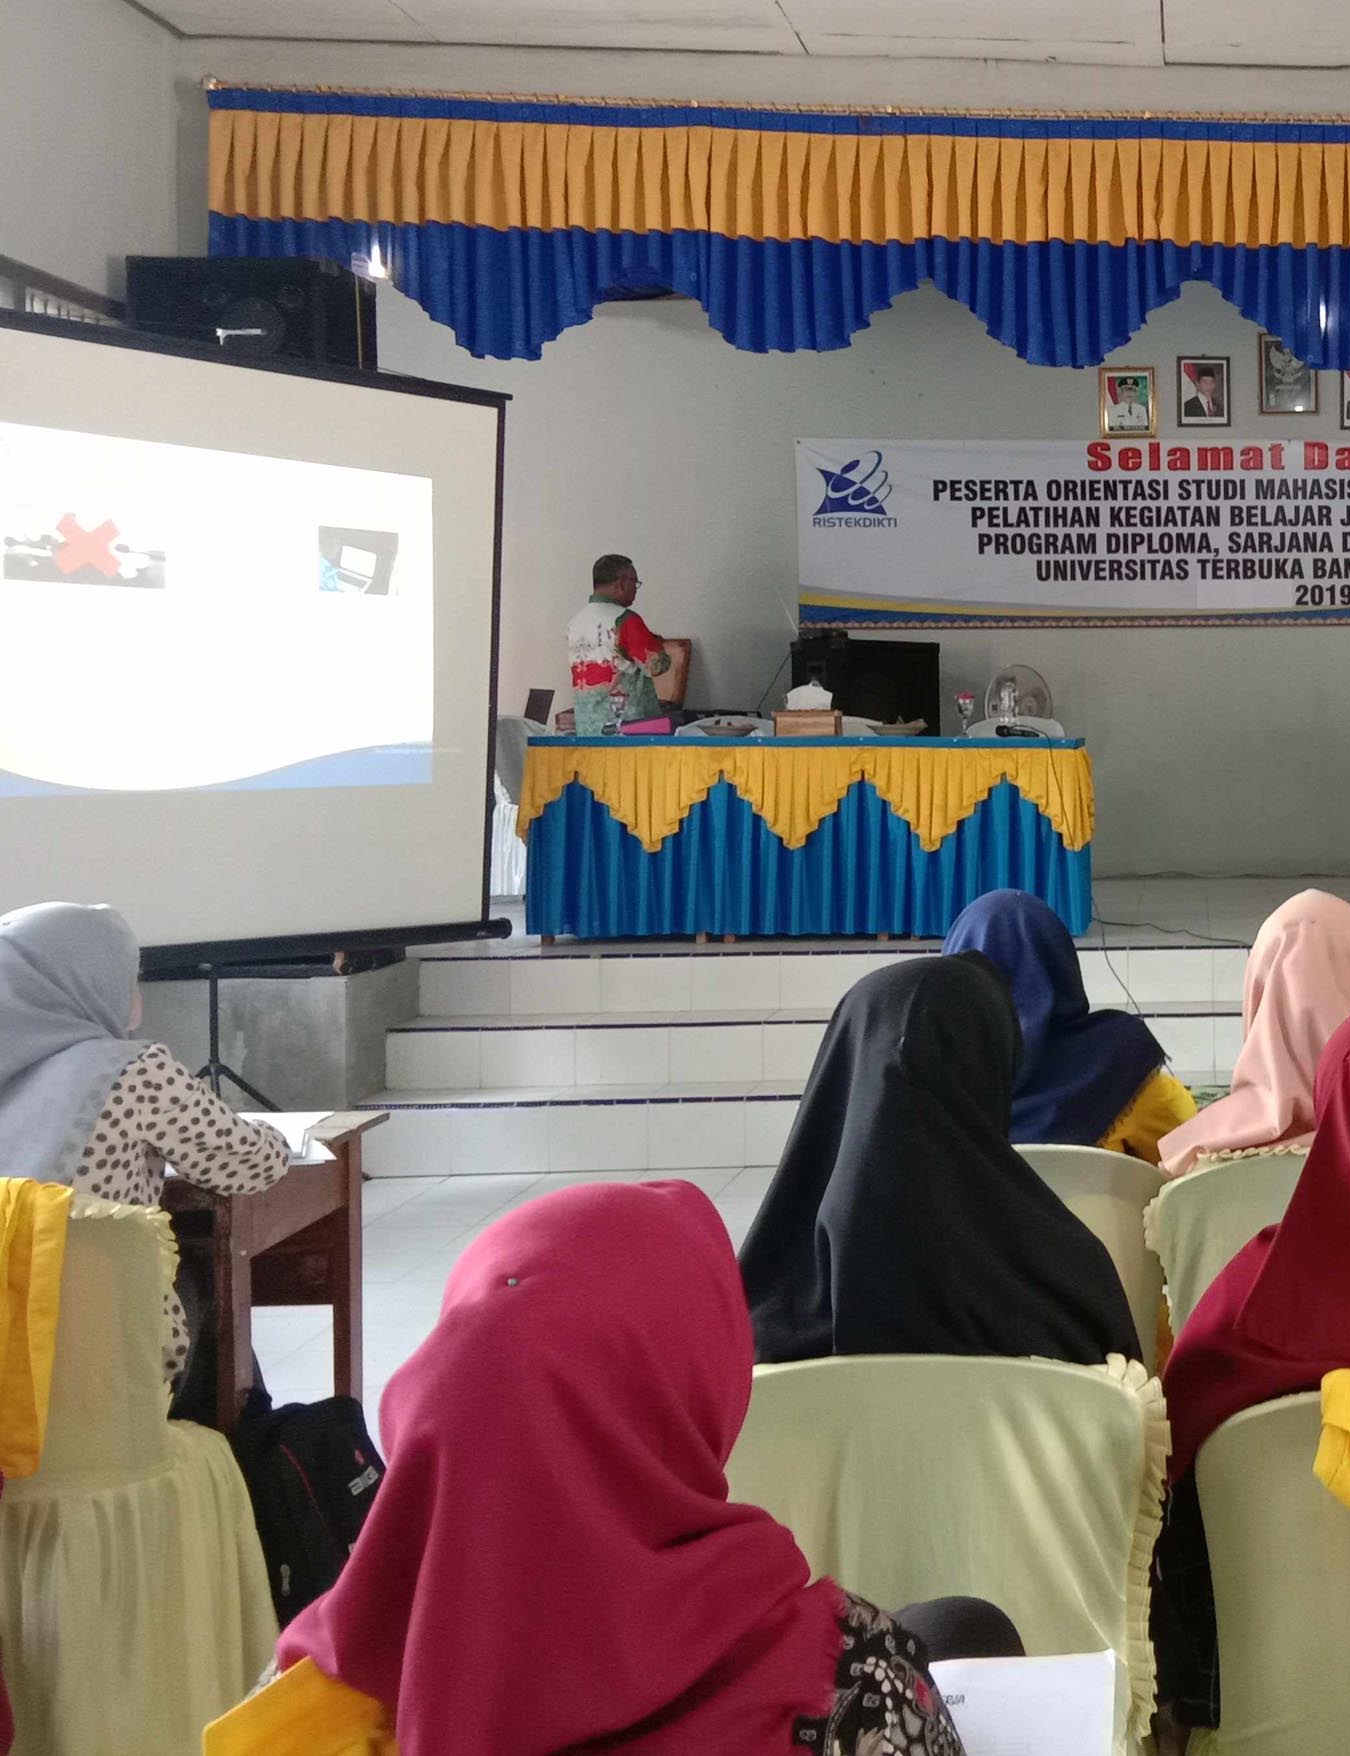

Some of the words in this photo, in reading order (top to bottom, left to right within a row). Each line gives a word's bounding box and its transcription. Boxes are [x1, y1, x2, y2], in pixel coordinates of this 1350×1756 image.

[1087, 442, 1285, 472] Selamat
[933, 480, 1038, 503] PESERTA
[1047, 479, 1170, 503] ORIENTASI
[1178, 479, 1247, 502] STUDI
[812, 517, 897, 528] RISTEKDIKTI
[971, 507, 1102, 530] PELATIHAN
[1110, 506, 1222, 529] KEGIATAN
[1230, 506, 1334, 528] BELAJAR
[978, 533, 1098, 557] PROGRAM
[1107, 533, 1221, 559] DIPLOMA,
[1229, 532, 1335, 555] SARJANA
[1037, 559, 1191, 583] UNIVERSITAS
[1197, 559, 1304, 581] TERBUKA
